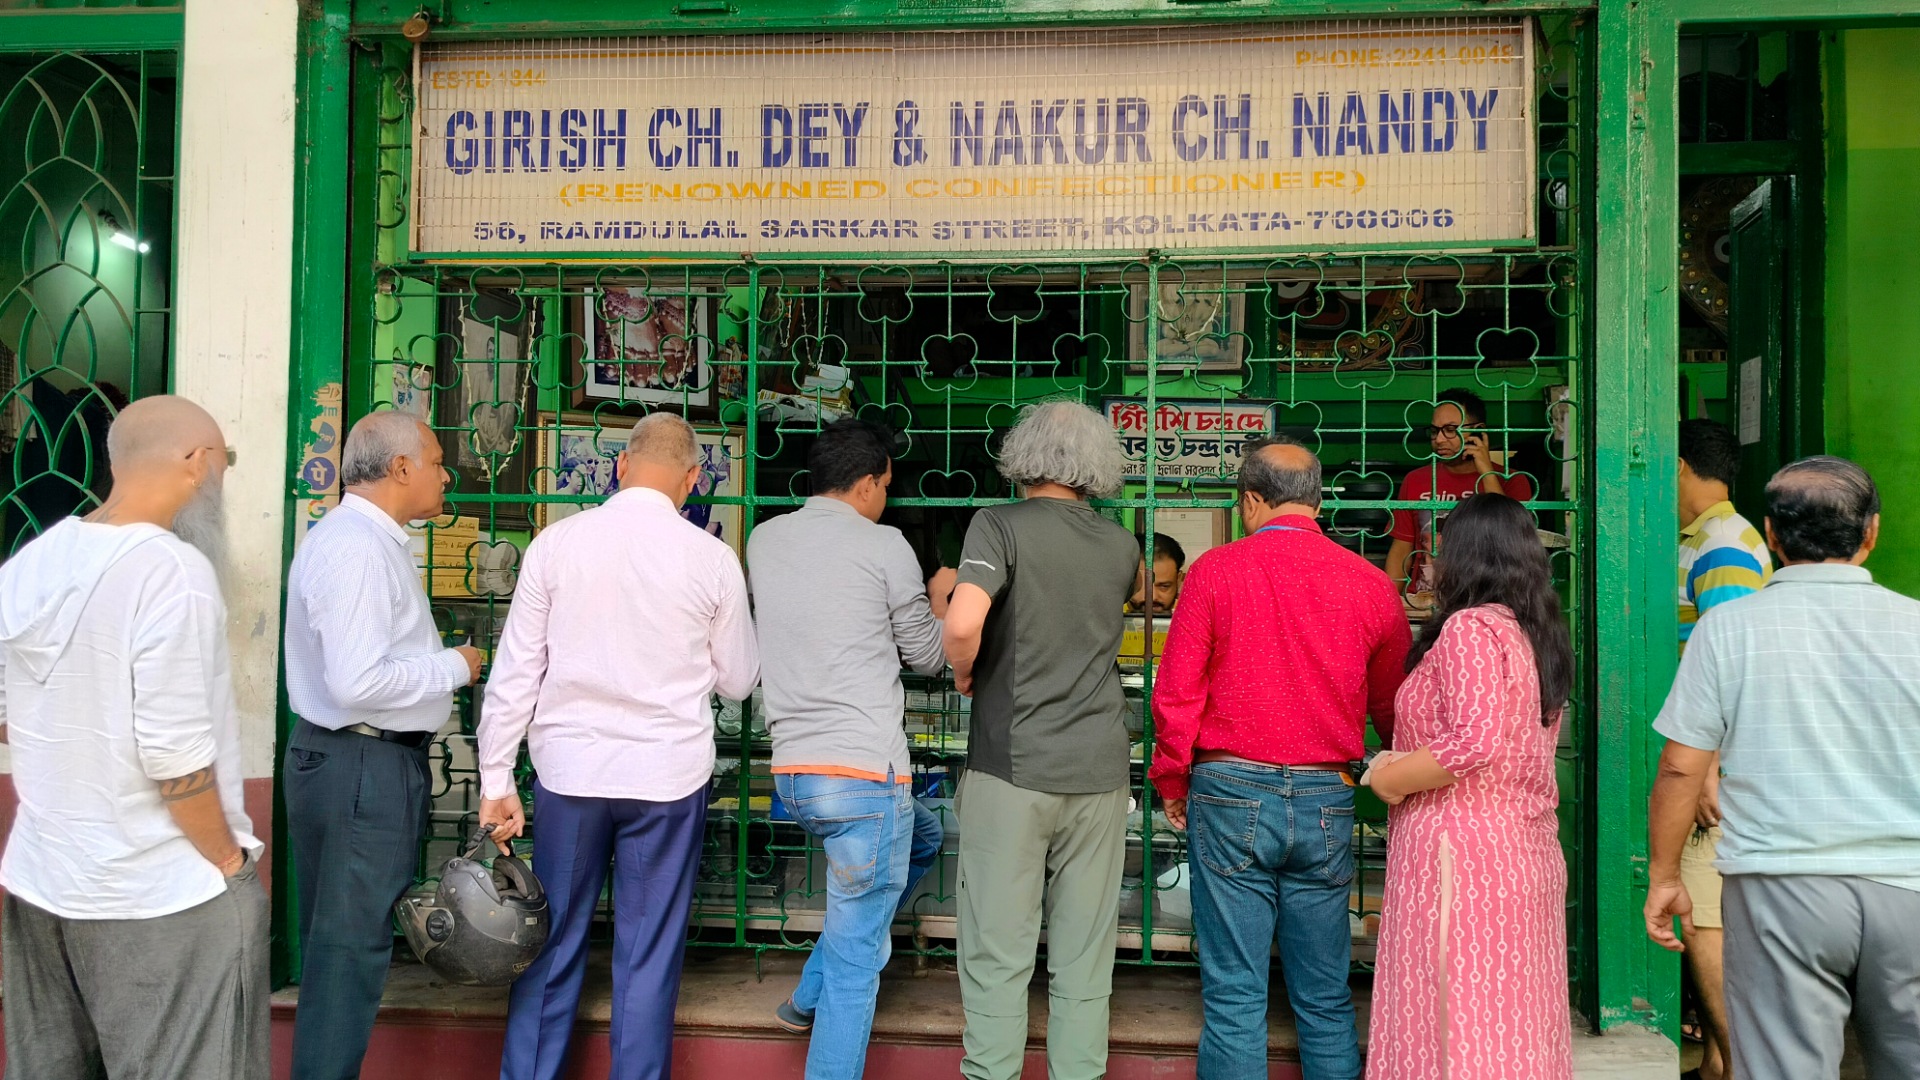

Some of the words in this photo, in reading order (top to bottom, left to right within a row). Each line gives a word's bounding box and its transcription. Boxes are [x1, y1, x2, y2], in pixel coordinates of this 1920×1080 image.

[432, 70, 491, 89] ESTD
[498, 68, 547, 87] 1844
[445, 107, 627, 176] GIRISH
[648, 105, 739, 171] CH.
[761, 101, 869, 168] DEY
[893, 100, 928, 167] &
[949, 98, 1152, 167] NAKUR
[1171, 93, 1269, 161] CH.
[1293, 87, 1499, 158] NANDY
[559, 179, 888, 208] (RENOWNED
[905, 170, 1368, 199] CONFECTIONER)
[473, 221, 526, 245] 56,
[540, 219, 747, 241] RAMDULAL
[760, 218, 920, 240] SARKAR
[932, 216, 1091, 242] STREET,
[1104, 208, 1455, 238] KOLKATA-700006
[1236, 413, 1265, 431] দে
